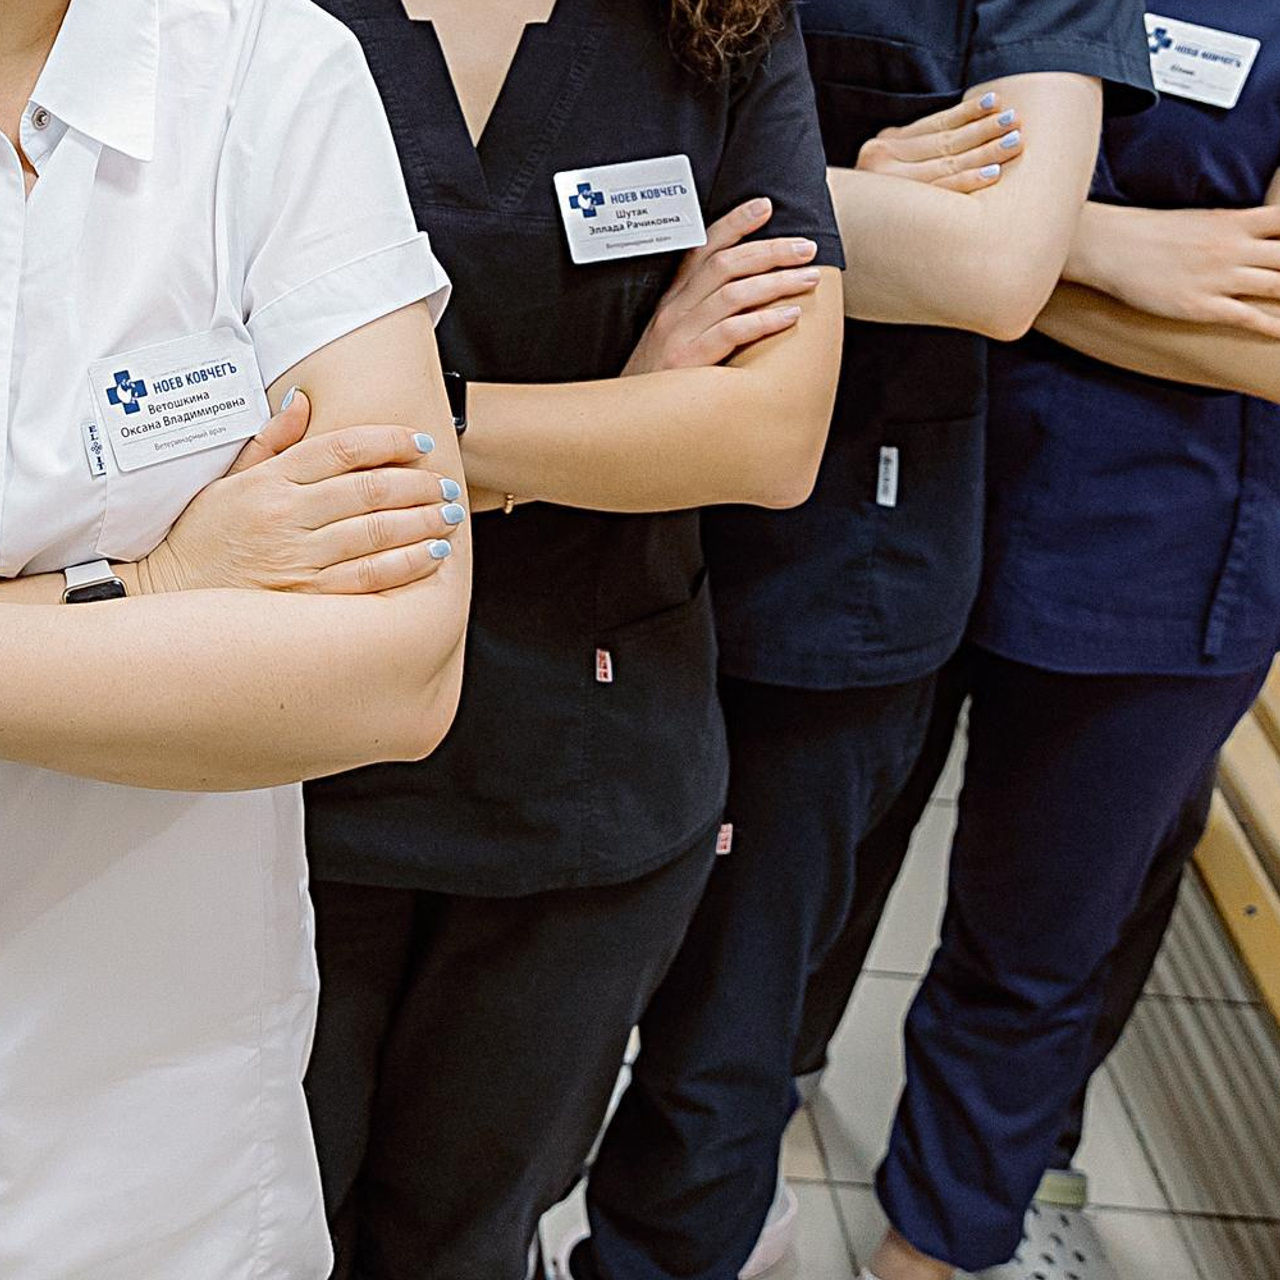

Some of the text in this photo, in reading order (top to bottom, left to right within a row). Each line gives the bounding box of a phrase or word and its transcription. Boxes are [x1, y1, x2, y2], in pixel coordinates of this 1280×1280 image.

[610, 191, 638, 204] НОЕВ
[640, 184, 687, 200] КОВЧЕГЪ
[615, 208, 649, 220] Шутак
[153, 376, 184, 394] НОЕВ
[185, 362, 237, 385] КОВЧЕГЪ
[147, 391, 210, 415] Ветошкина
[120, 397, 246, 438] Оксана Владимировна
